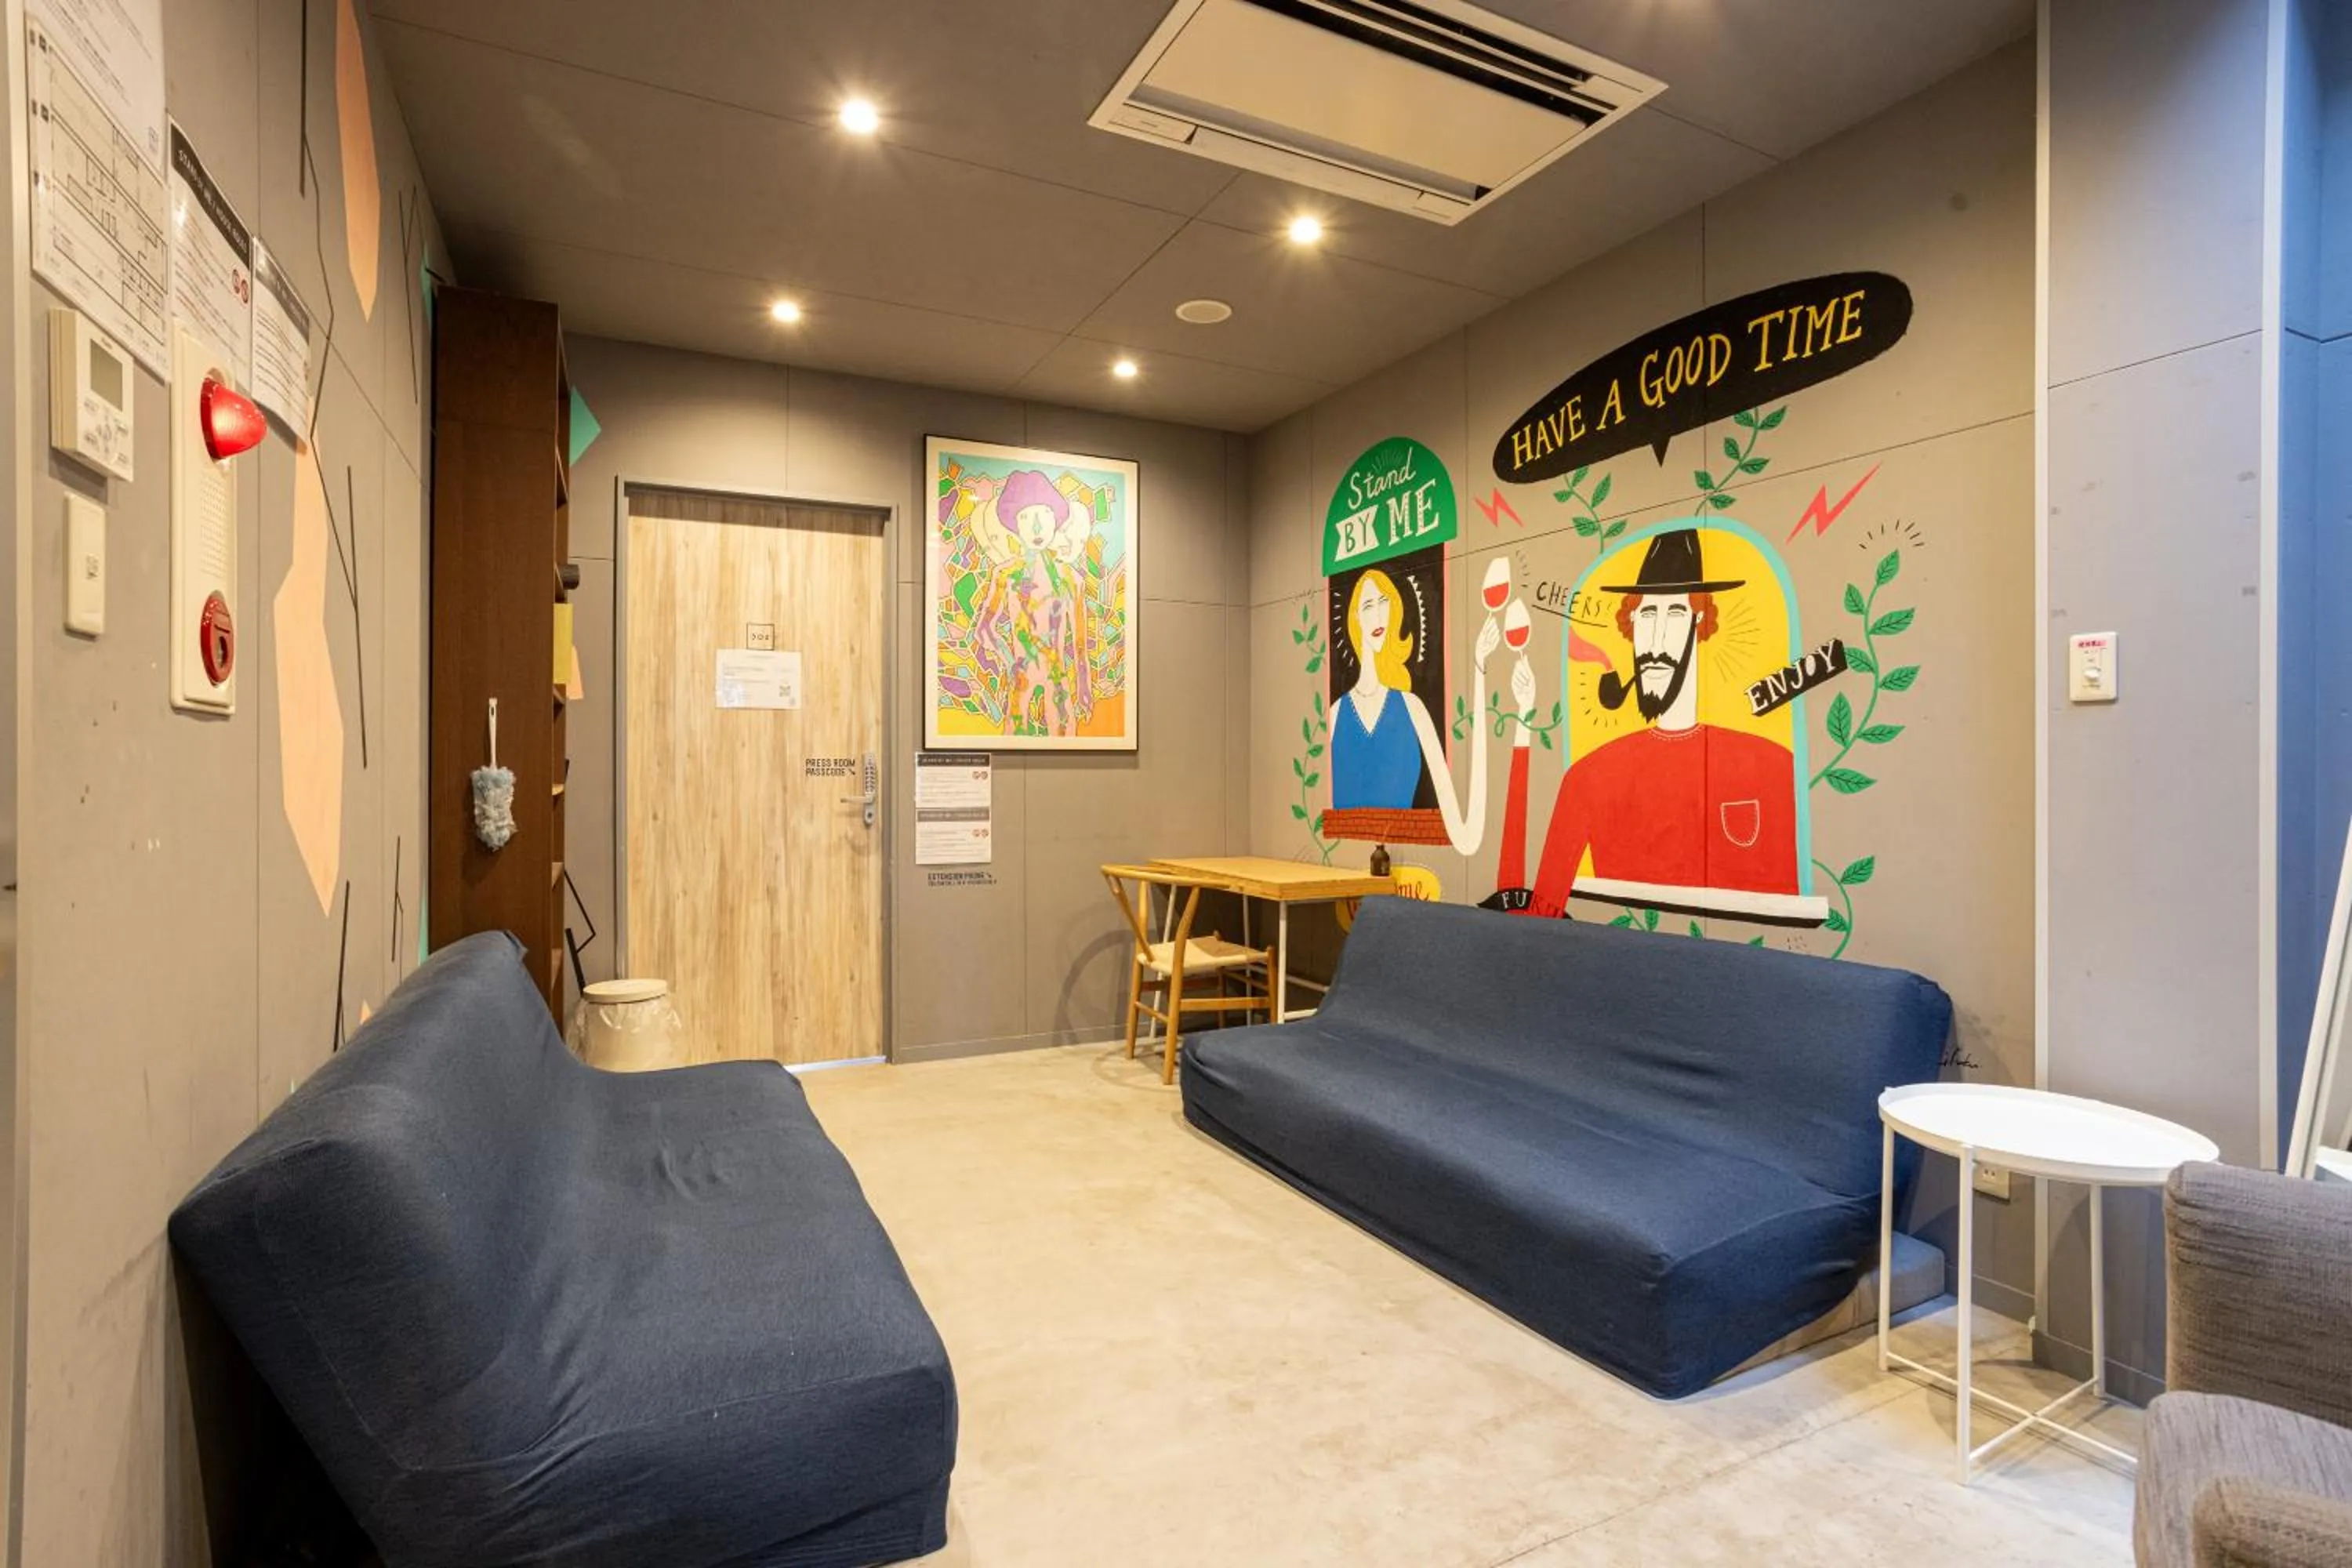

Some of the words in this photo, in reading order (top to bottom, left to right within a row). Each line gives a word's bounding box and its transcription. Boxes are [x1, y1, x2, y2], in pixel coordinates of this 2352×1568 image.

[1512, 394, 1586, 470] HAVE
[1596, 378, 1627, 430] A
[1640, 333, 1732, 408] GOOD
[1748, 289, 1866, 372] TIME
[1348, 446, 1417, 510] Stand
[1345, 511, 1370, 553] BY
[1385, 478, 1440, 547] ME
[1744, 638, 1836, 714] ENJOY
[805, 757, 831, 768] PRESS
[833, 757, 855, 768] ROOM
[805, 768, 845, 777] PASSCODE
